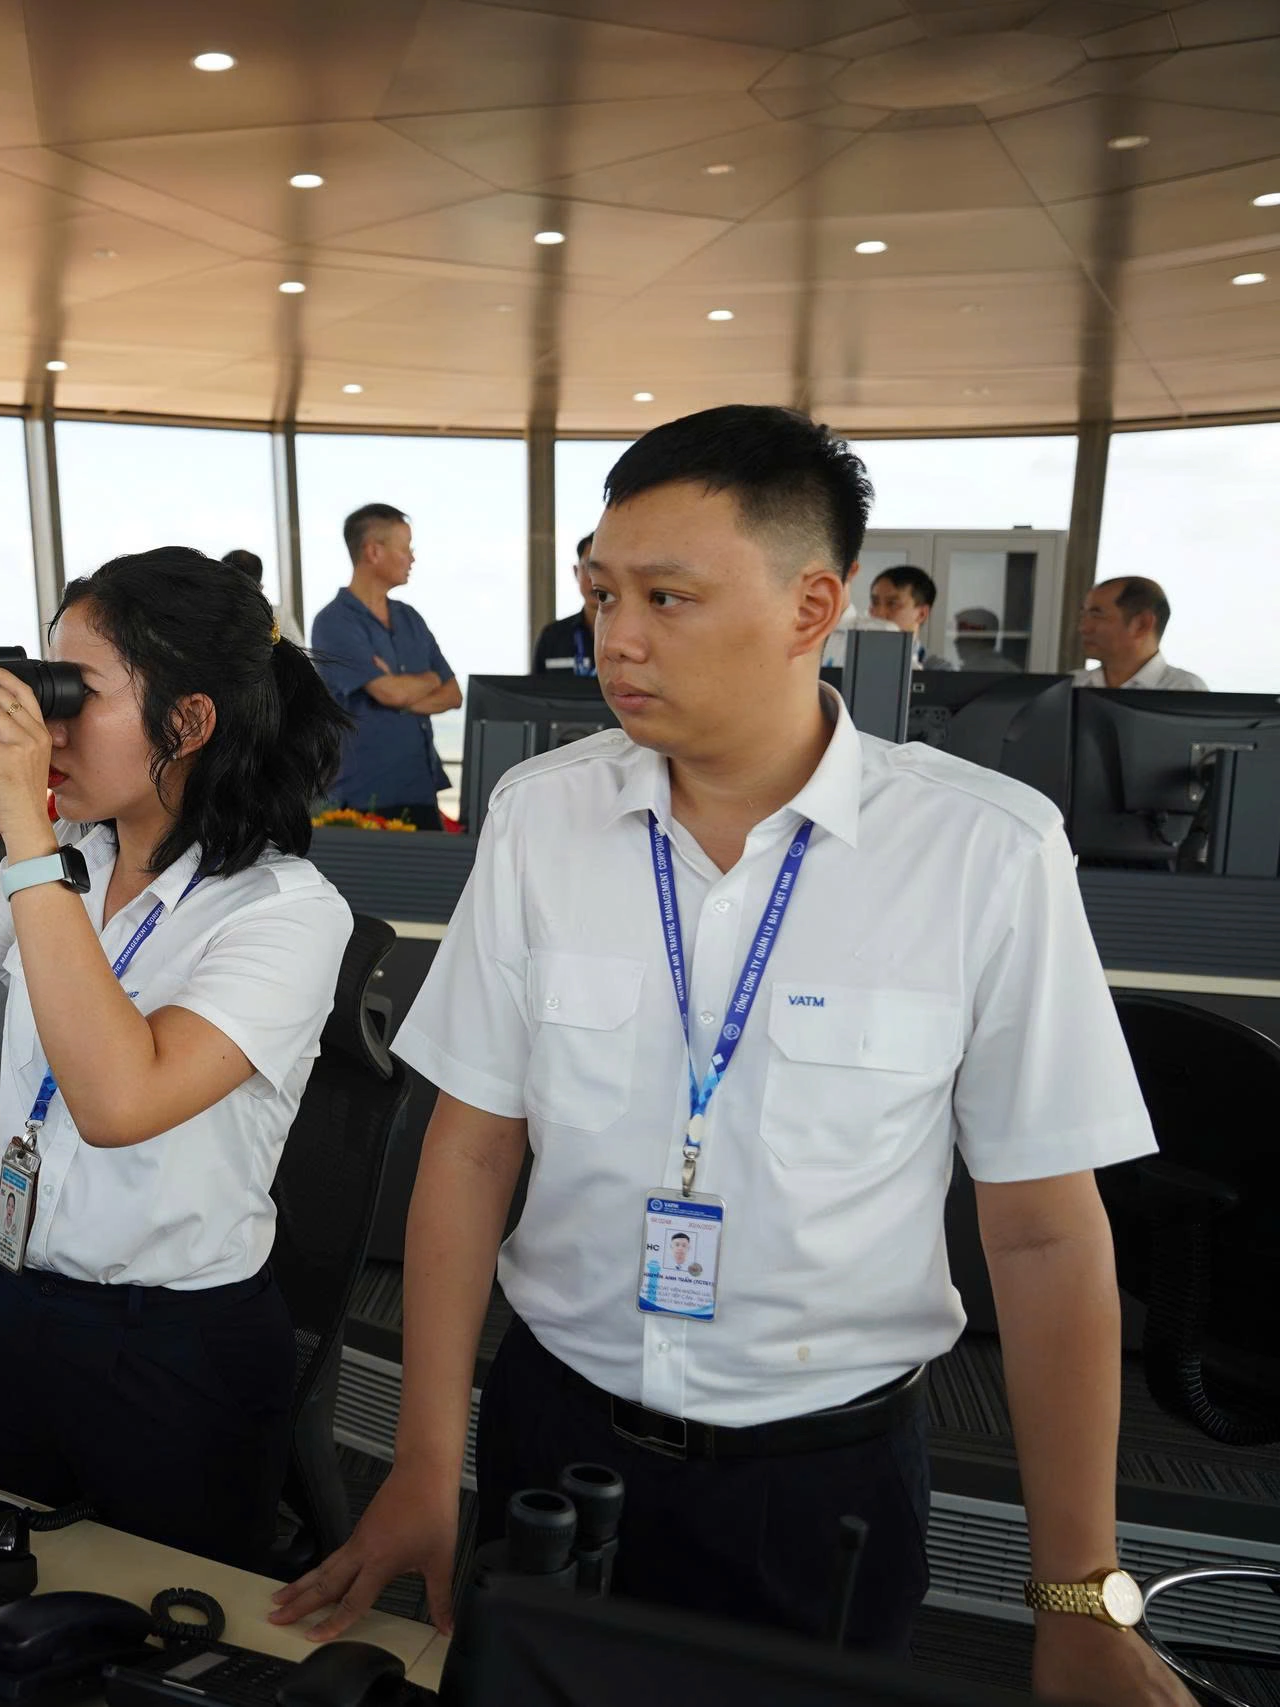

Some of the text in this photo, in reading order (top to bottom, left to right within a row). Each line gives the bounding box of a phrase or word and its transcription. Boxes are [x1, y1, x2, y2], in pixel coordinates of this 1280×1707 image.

[780, 872, 793, 889] NAM
[658, 872, 675, 921] MANAGEMENT
[774, 890, 787, 907] VIỆT
[769, 908, 780, 924] BAY
[669, 922, 680, 952] TRAFFIC
[113, 963, 122, 975] FIC
[120, 926, 148, 964] MANAGEMENT
[755, 937, 769, 959] QUẢN
[672, 951, 682, 967] AIR
[751, 959, 762, 971] TY
[674, 969, 684, 1001] VIETNAM
[743, 971, 758, 992] CÔNG
[734, 993, 749, 1014] TỔNG
[788, 995, 825, 1007] VATM
[646, 1243, 660, 1252] HC
